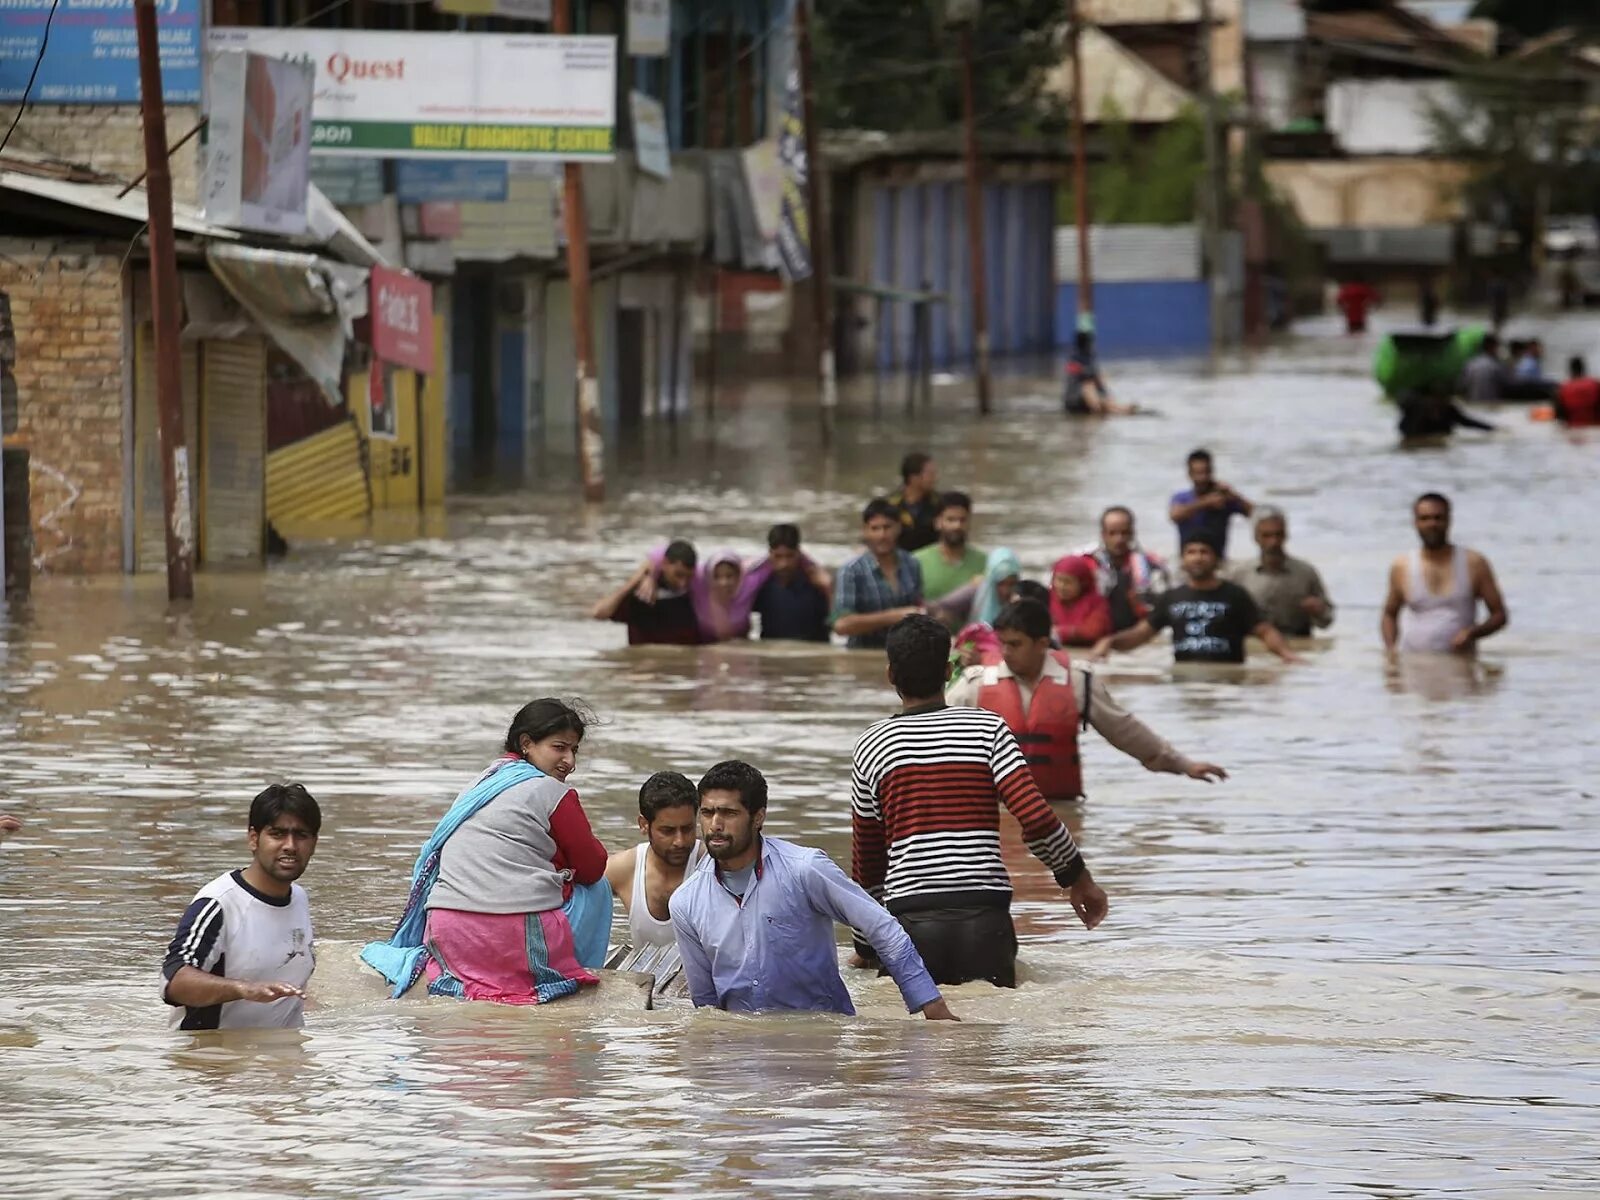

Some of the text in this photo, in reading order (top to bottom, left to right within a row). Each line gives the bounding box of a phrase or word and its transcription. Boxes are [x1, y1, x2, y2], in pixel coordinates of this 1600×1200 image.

[326, 52, 405, 84] Quest
[413, 124, 612, 151] VALLEY DIAGNOSTIC CENTRE
